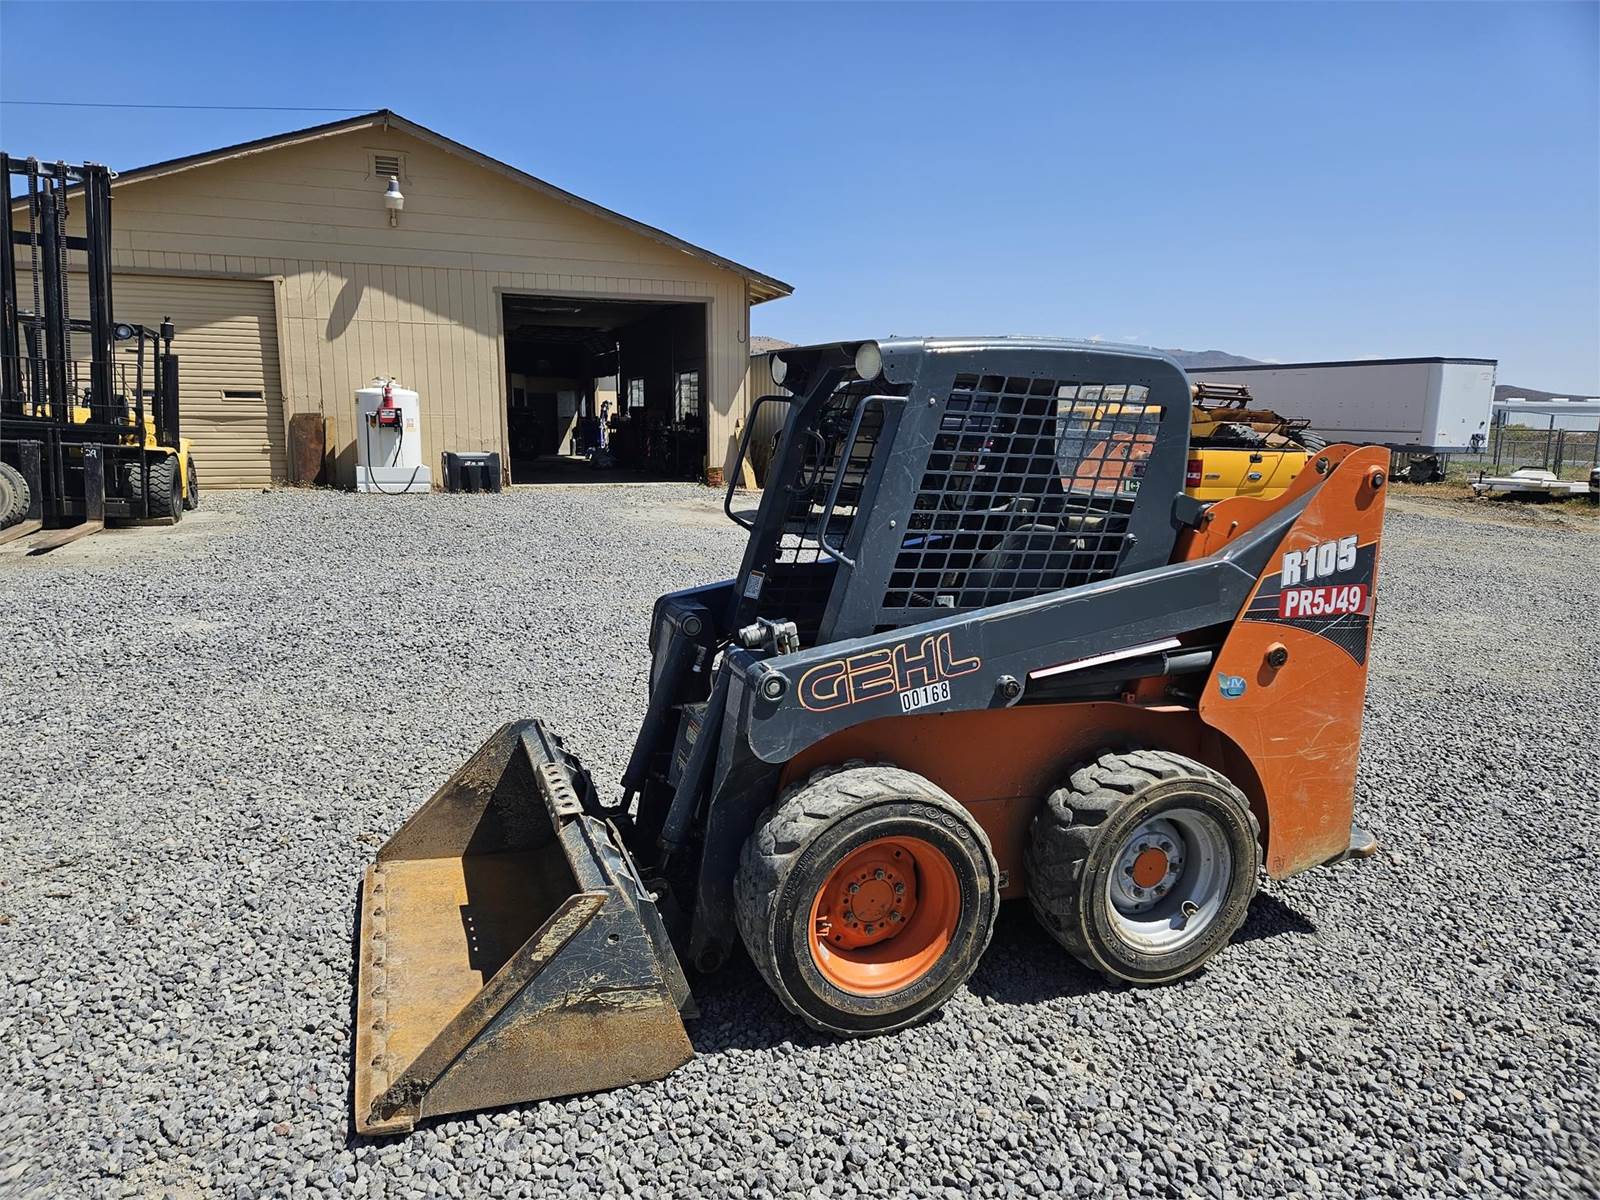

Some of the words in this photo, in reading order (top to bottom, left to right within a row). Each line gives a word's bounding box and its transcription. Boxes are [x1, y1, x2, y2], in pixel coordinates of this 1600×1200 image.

[1281, 535, 1358, 588] R105
[1285, 586, 1361, 617] PR5J49
[798, 632, 980, 711] GEHL
[902, 682, 949, 710] 00168
